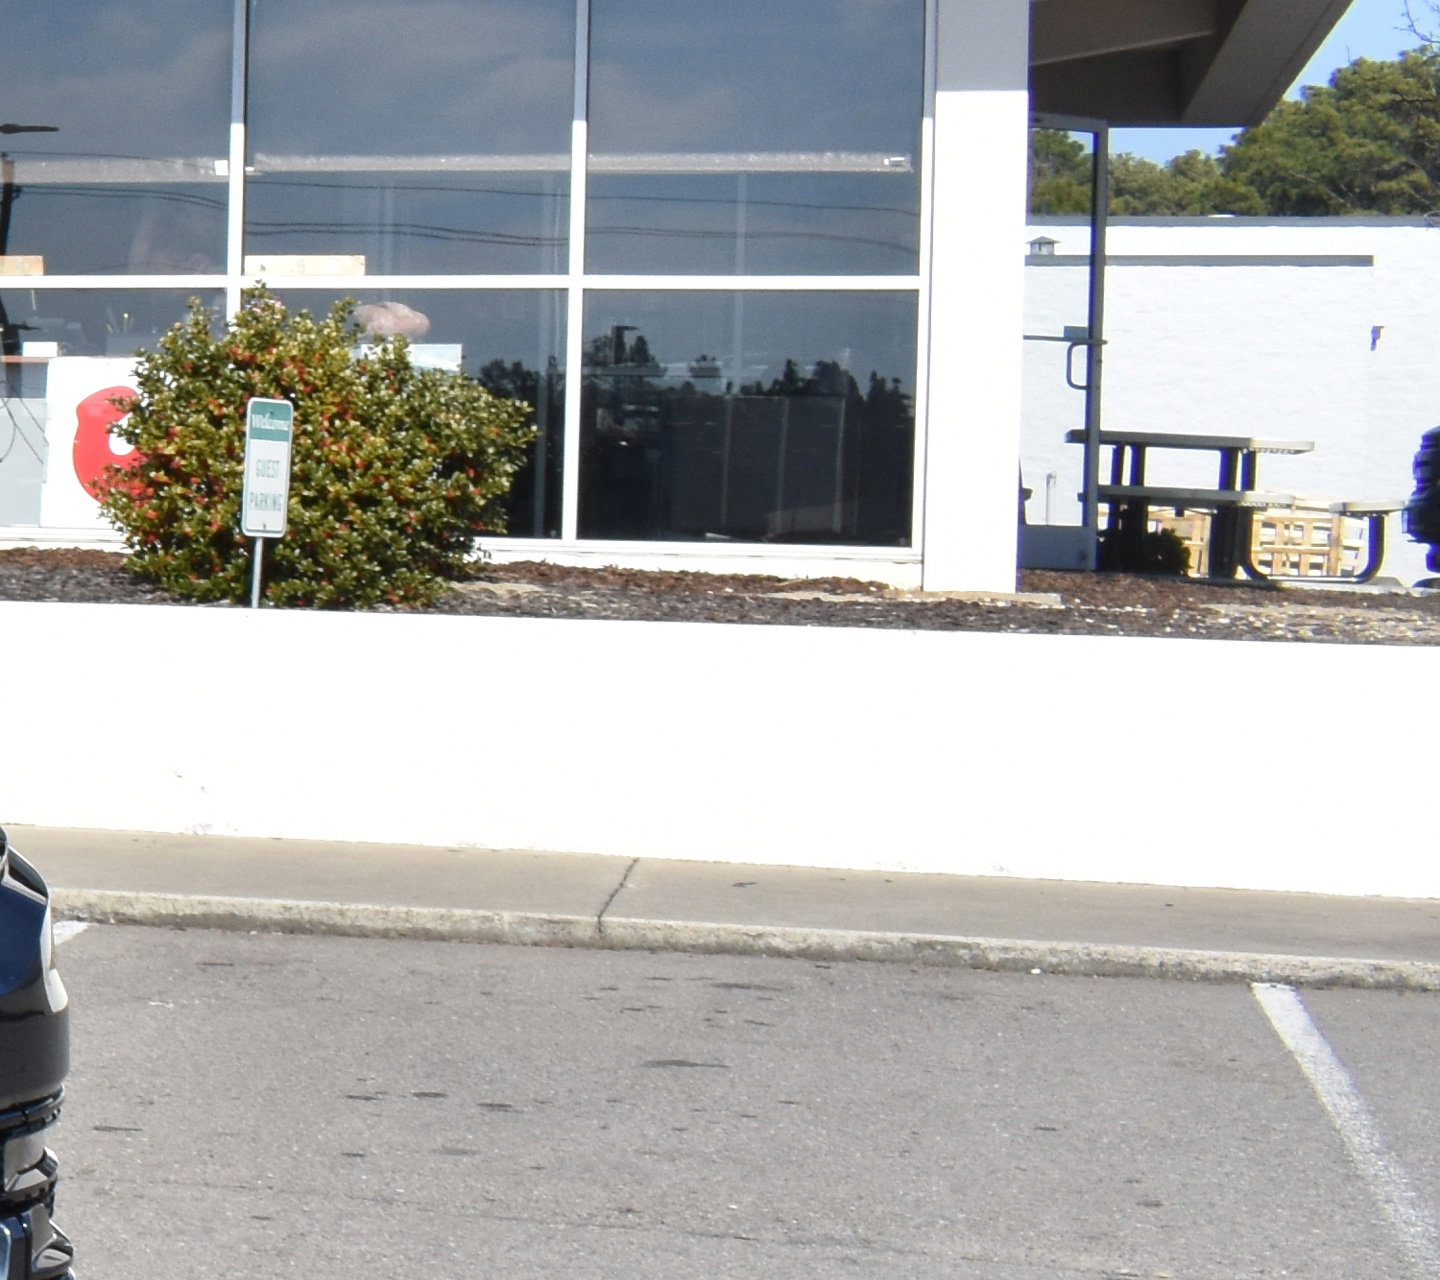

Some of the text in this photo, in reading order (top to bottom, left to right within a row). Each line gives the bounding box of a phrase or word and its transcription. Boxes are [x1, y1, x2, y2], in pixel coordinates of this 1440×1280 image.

[251, 412, 290, 432] Welcome
[255, 458, 281, 478] GUEST
[249, 491, 283, 512] PARKING
